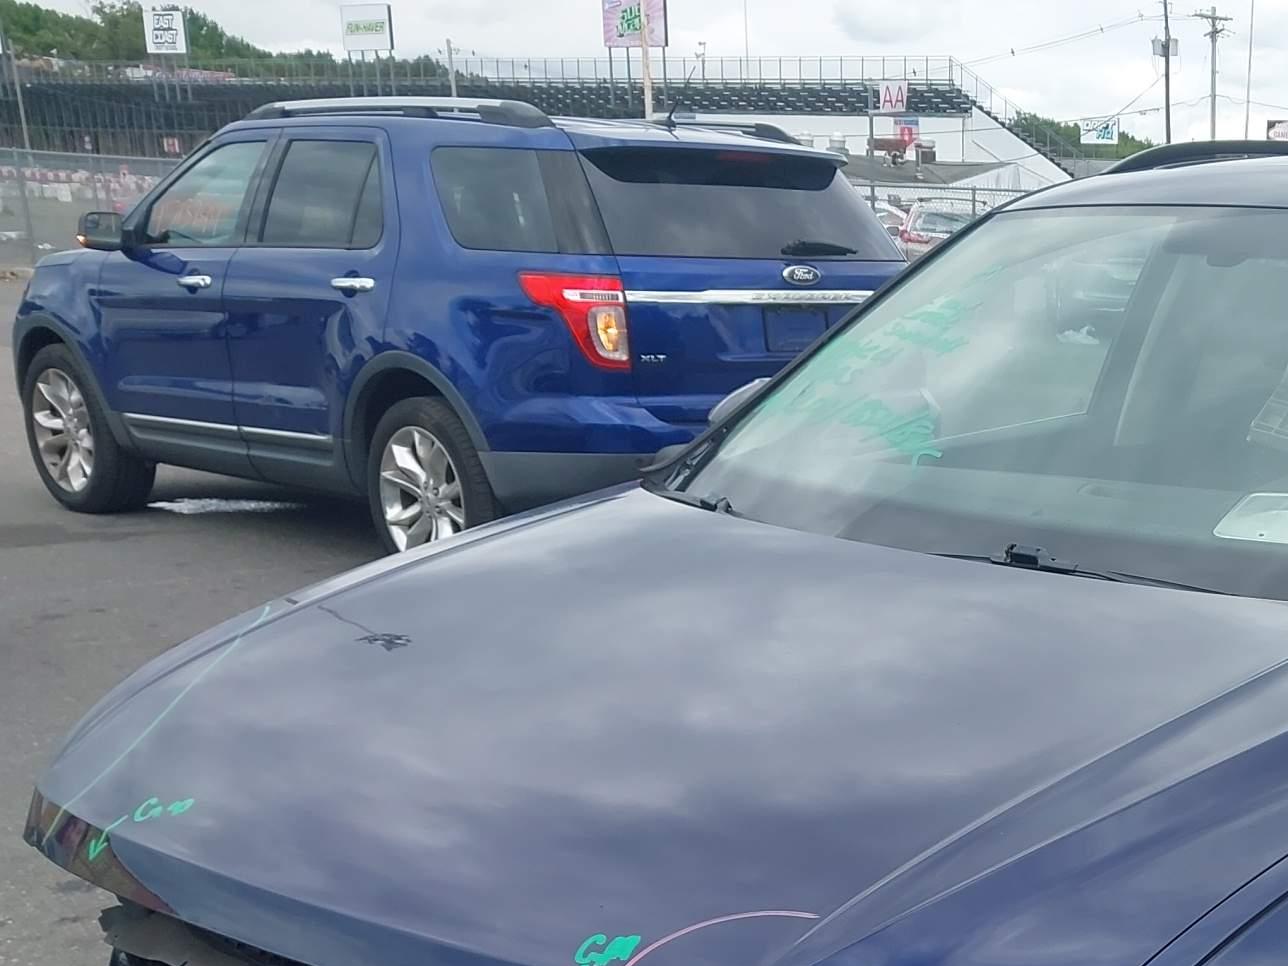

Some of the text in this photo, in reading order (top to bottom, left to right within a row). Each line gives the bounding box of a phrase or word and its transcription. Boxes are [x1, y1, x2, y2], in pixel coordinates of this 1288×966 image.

[153, 13, 173, 29] EAST
[152, 29, 177, 44] COAST
[882, 85, 904, 109] AA
[793, 268, 814, 280] Ford
[640, 354, 668, 362] XLT
